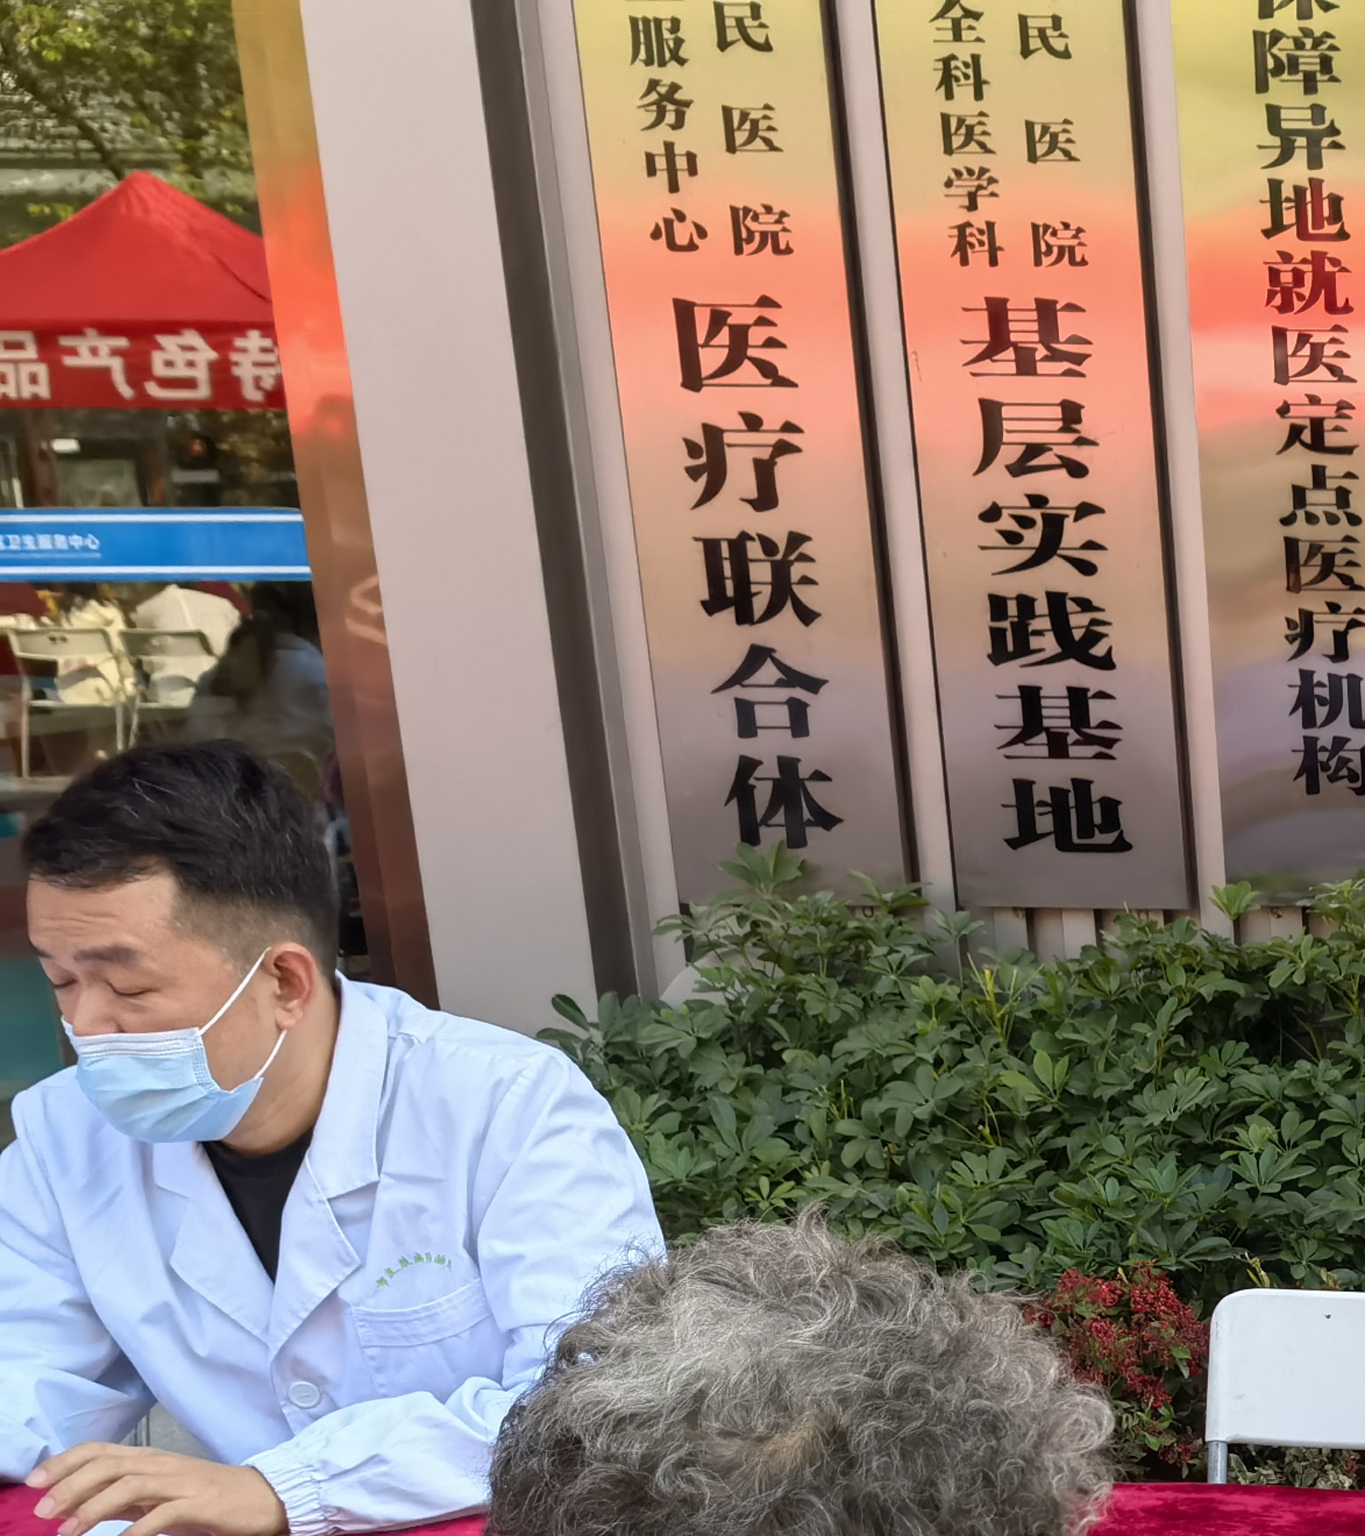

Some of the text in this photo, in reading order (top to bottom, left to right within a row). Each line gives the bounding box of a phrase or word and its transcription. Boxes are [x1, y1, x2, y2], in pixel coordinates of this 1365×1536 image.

[929, 0, 1005, 268] 全科医学科
[1017, 13, 1089, 268] 民医院
[672, 294, 844, 849] 医疗联合体
[959, 296, 1134, 854] 基层实践基地
